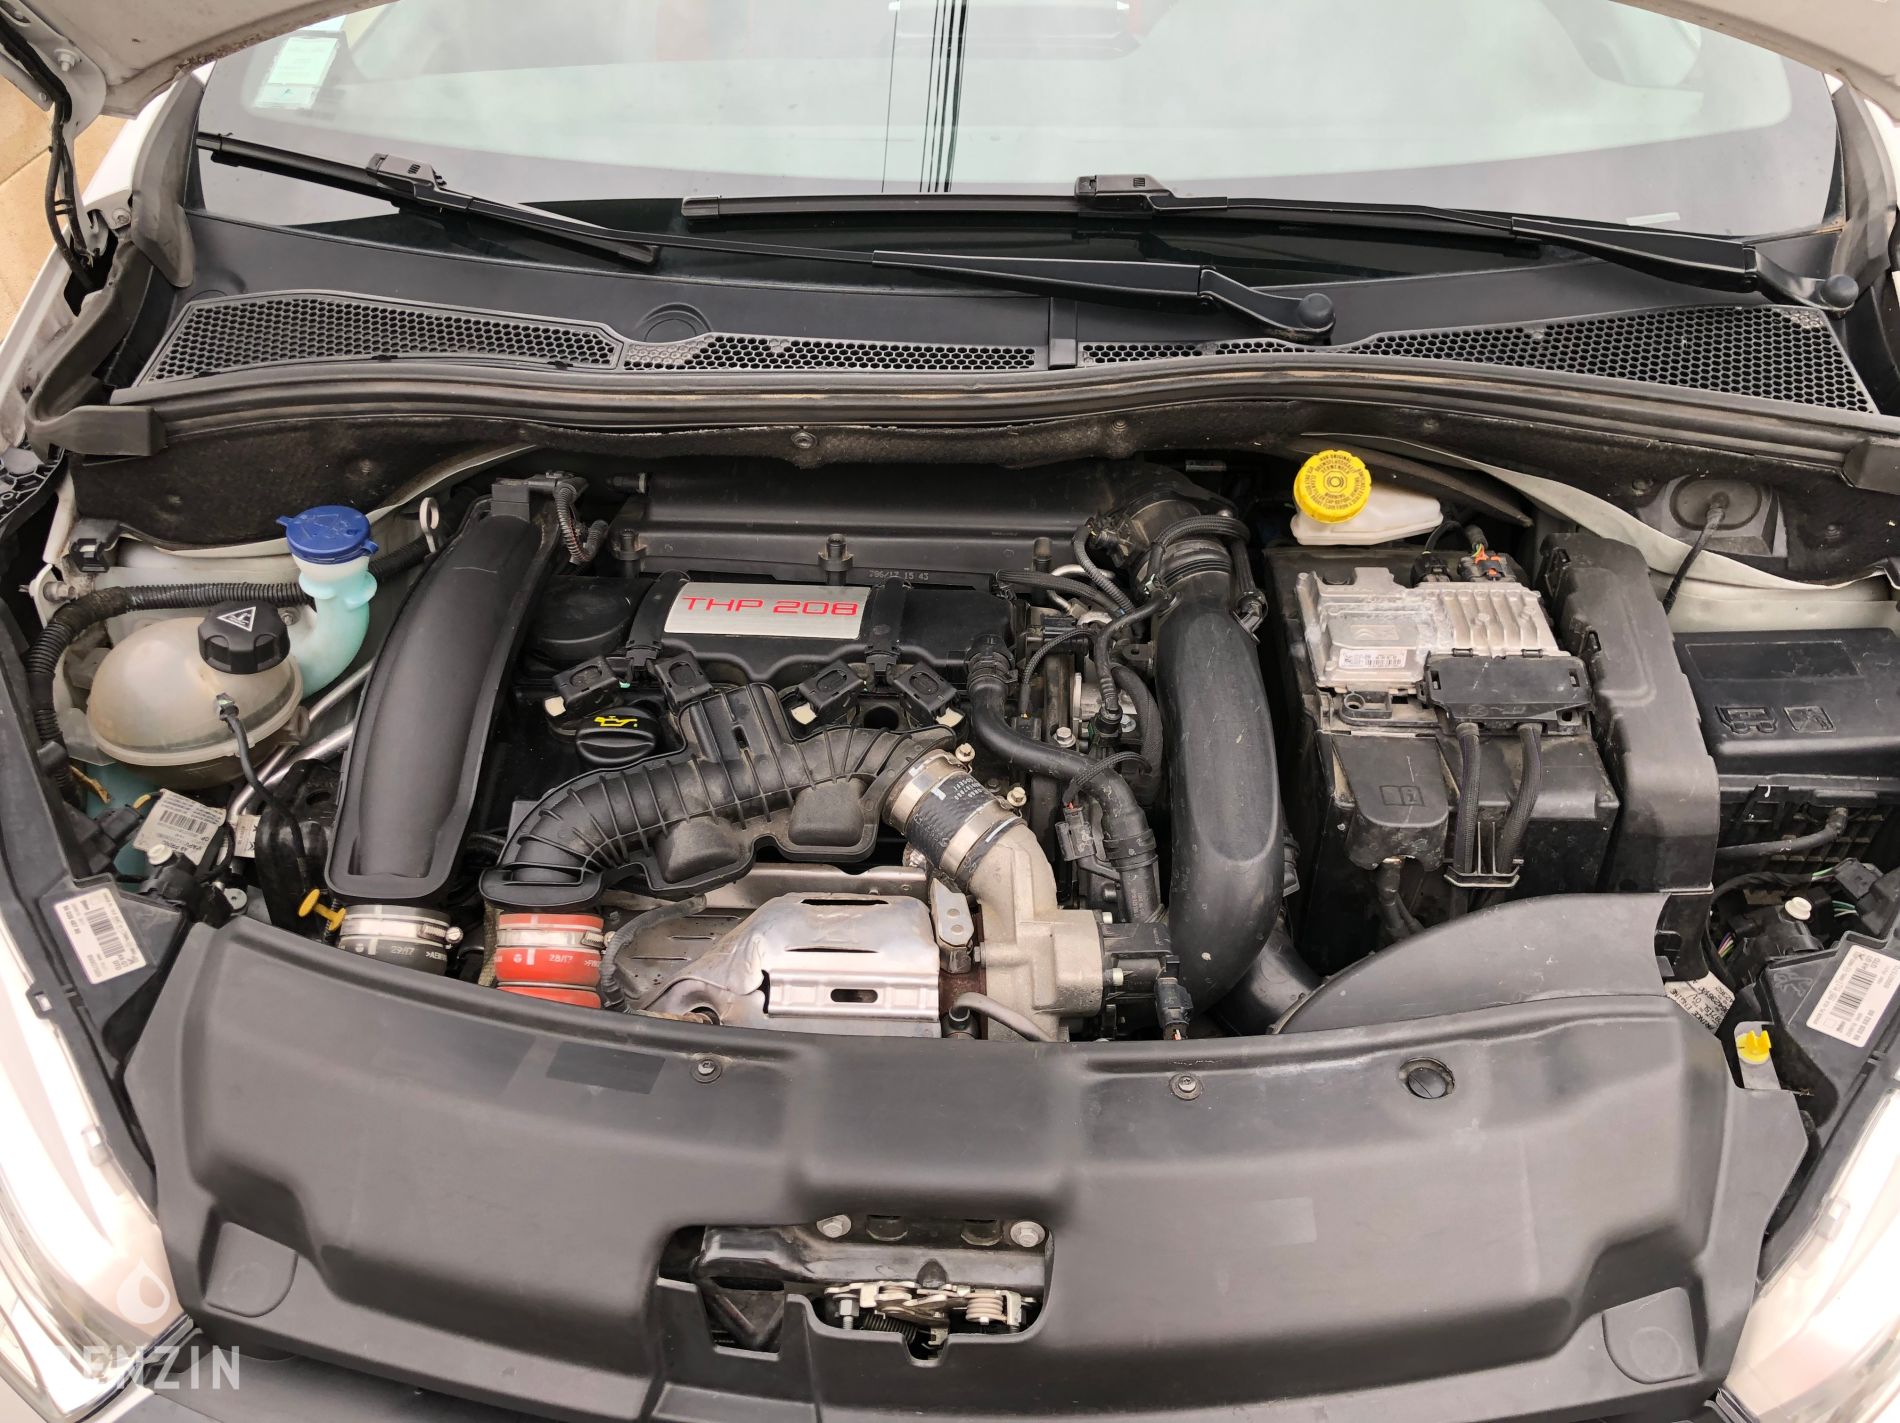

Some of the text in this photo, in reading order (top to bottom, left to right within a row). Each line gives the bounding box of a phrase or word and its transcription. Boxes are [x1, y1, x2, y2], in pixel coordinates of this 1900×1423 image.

[682, 596, 858, 617] THP 208
[1669, 988, 1693, 1011] ENGINE
